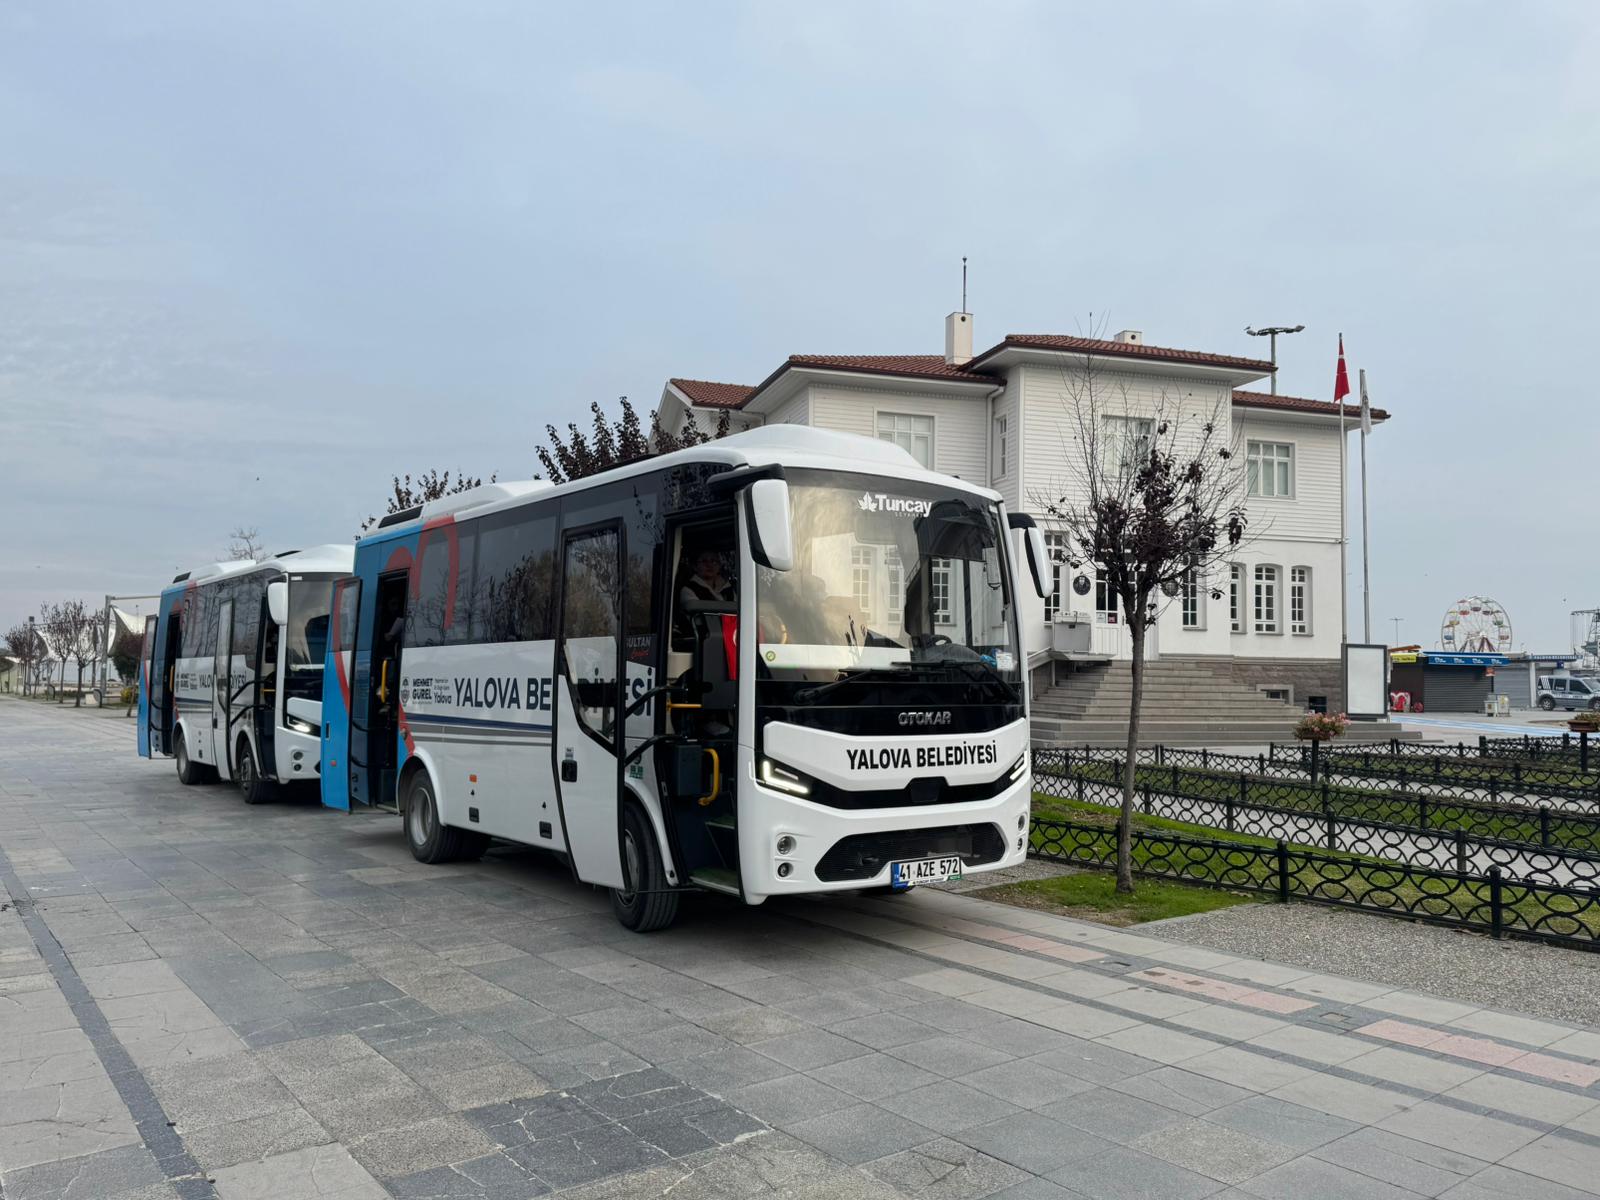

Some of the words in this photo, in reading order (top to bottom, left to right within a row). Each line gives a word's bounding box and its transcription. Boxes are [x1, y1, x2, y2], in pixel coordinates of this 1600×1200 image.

[875, 494, 932, 517] Tuncay
[454, 677, 521, 709] YALOVA
[898, 711, 951, 726] OTOKAR
[847, 748, 912, 770] YALOVA
[916, 740, 997, 767] BELEDİYESİ
[900, 864, 911, 880] 41
[916, 861, 935, 878] AZE
[940, 858, 958, 875] 572
